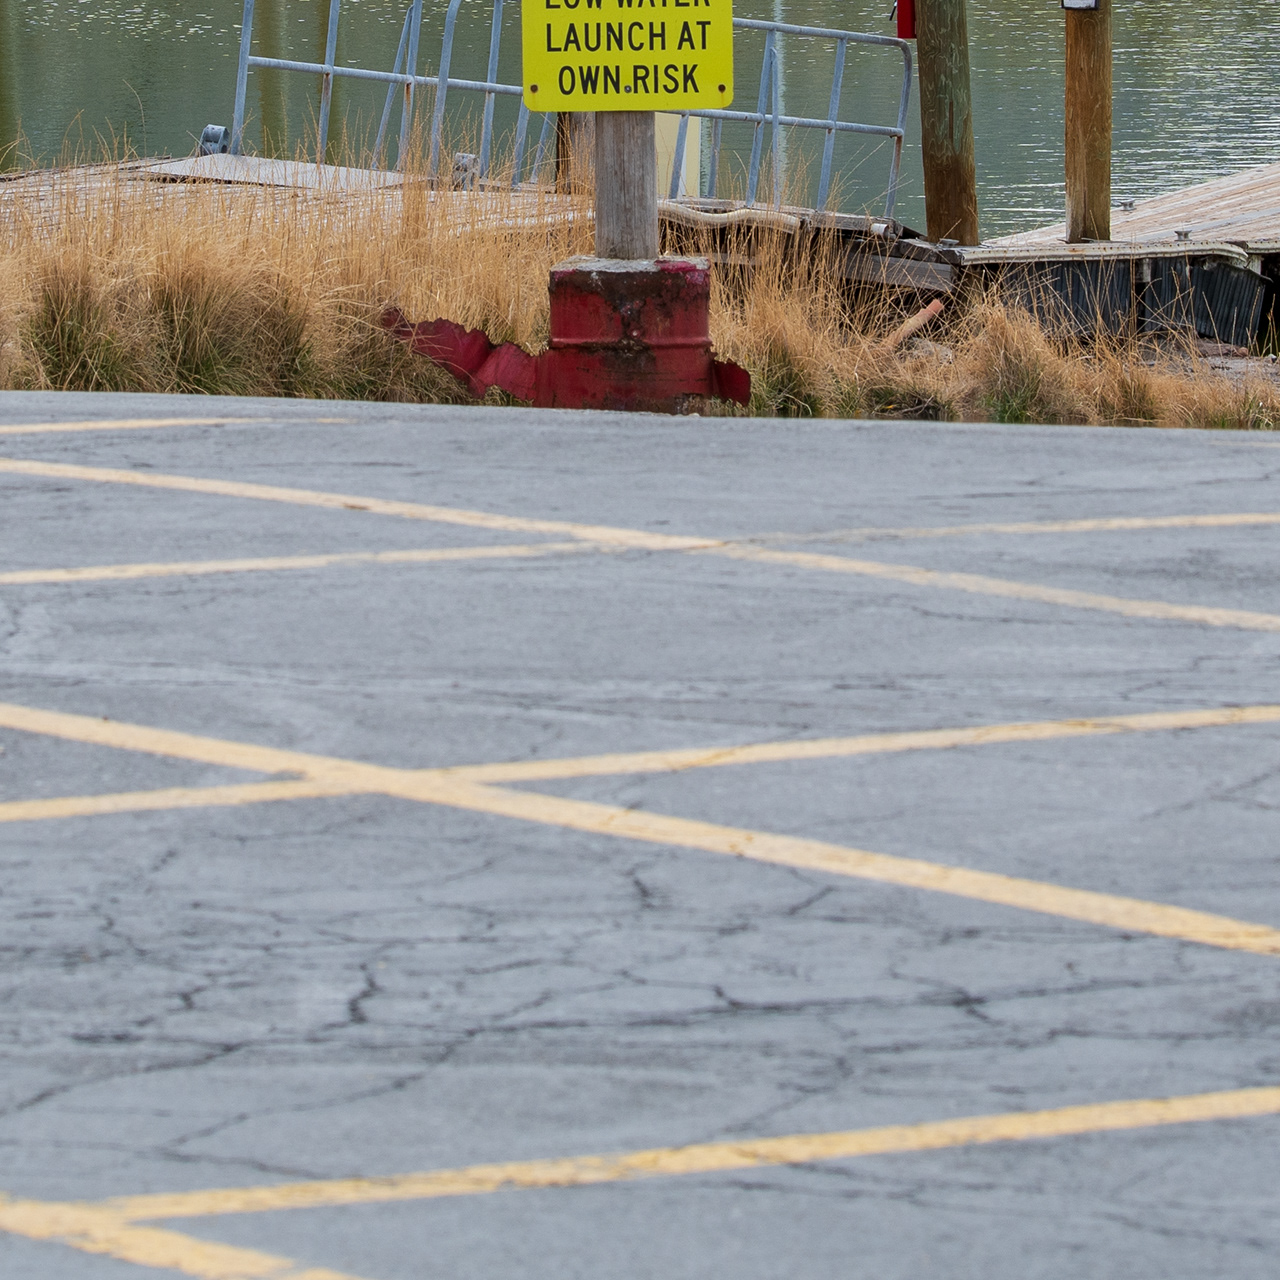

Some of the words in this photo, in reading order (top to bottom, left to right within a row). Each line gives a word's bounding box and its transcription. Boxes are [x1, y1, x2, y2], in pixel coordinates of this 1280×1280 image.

[546, 22, 666, 53] LAUNCH
[677, 20, 712, 51] AT
[558, 65, 620, 95] OWN
[633, 63, 700, 94] RISK
